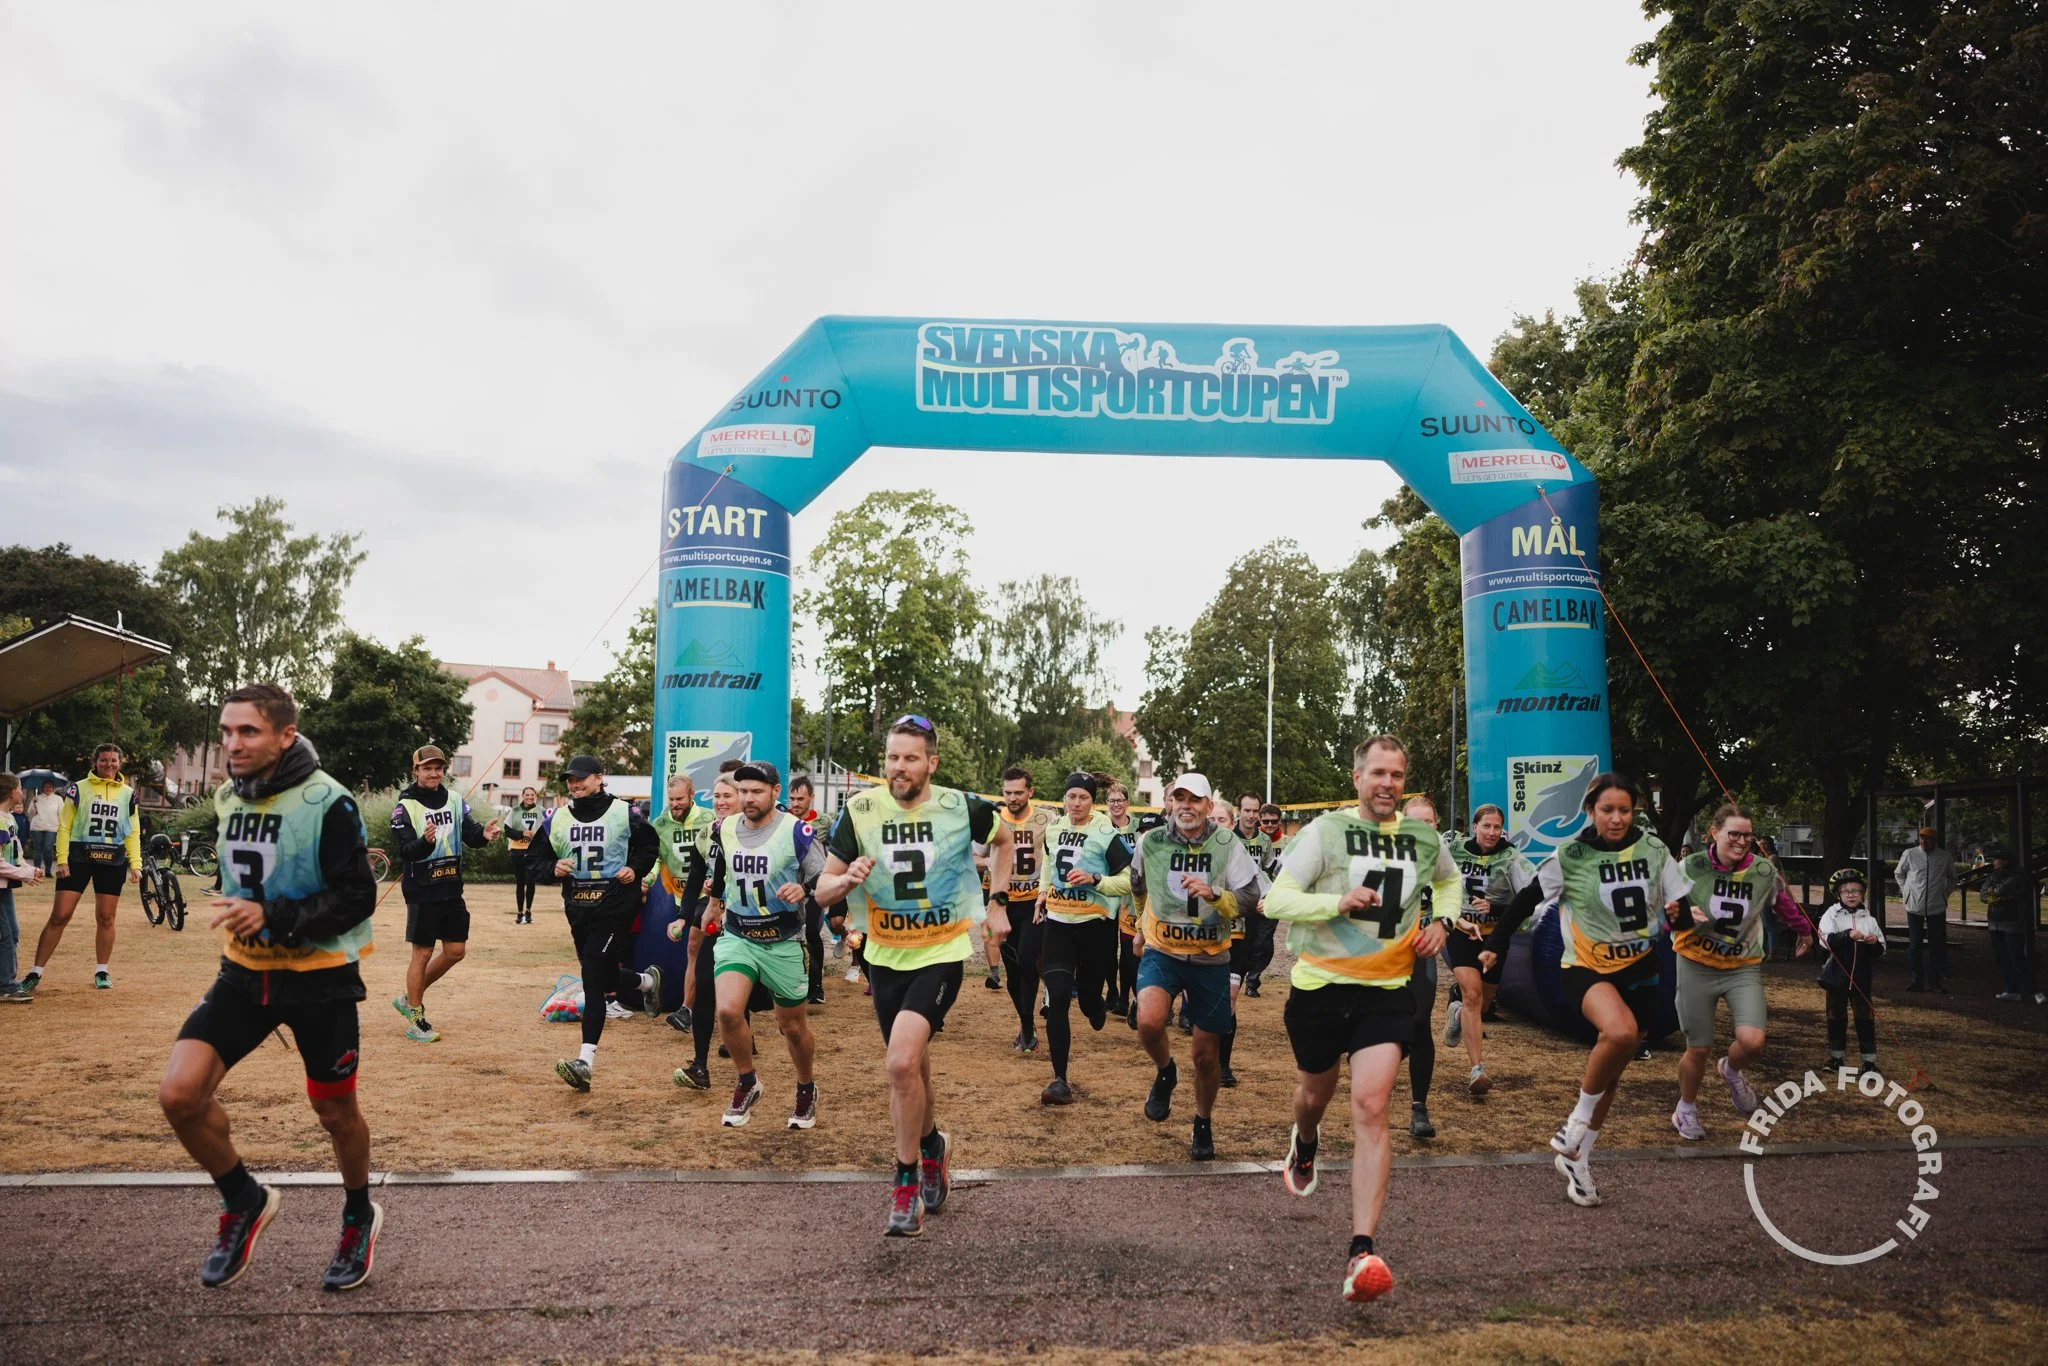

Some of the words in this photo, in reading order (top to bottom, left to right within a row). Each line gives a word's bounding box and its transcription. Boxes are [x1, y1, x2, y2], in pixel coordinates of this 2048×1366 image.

[924, 326, 1117, 369] SVENSKA
[729, 388, 842, 412] SUUNTO
[922, 366, 1330, 420] MULTISPORTCUPEN
[710, 429, 793, 443] MERRELL
[1420, 414, 1536, 437] SUUNTO
[1462, 454, 1551, 469] MERRELL
[1497, 471, 1529, 480] OUTSIDE
[667, 504, 768, 539] START
[1511, 516, 1586, 557] MÅL
[665, 577, 765, 610] CAMELBAK
[1493, 598, 1599, 631] CAMELBAK
[662, 670, 763, 690] montrail
[1495, 693, 1601, 714] montrail
[669, 736, 709, 748] Skinz
[1513, 761, 1562, 774] Skinz
[1513, 775, 1525, 812] Seal
[91, 801, 118, 817] ÖAR
[89, 818, 117, 838] 29
[226, 808, 283, 844] ÖAR
[525, 820, 535, 831] 7
[570, 824, 605, 842] ÖAR
[881, 819, 934, 845] ÖAR
[1012, 829, 1033, 844] AR
[1058, 829, 1088, 847] ÖAR
[1345, 824, 1418, 862] ÖAR
[572, 846, 604, 871] 12
[733, 851, 768, 875] ÖAR
[1056, 849, 1074, 882] 6
[1170, 850, 1212, 873] ÖAR
[1598, 858, 1650, 883] ÖAR
[232, 849, 265, 900] 3
[432, 867, 456, 878] JOAB
[893, 849, 928, 900] 2
[736, 878, 767, 907] 11
[1713, 875, 1753, 900] ÖAR
[1350, 866, 1404, 939] 4
[1611, 886, 1648, 932] 9
[880, 908, 950, 931] JOKAB
[1714, 901, 1744, 939] 2
[1162, 925, 1217, 941] JOKAB
[1604, 941, 1649, 960] JOK
